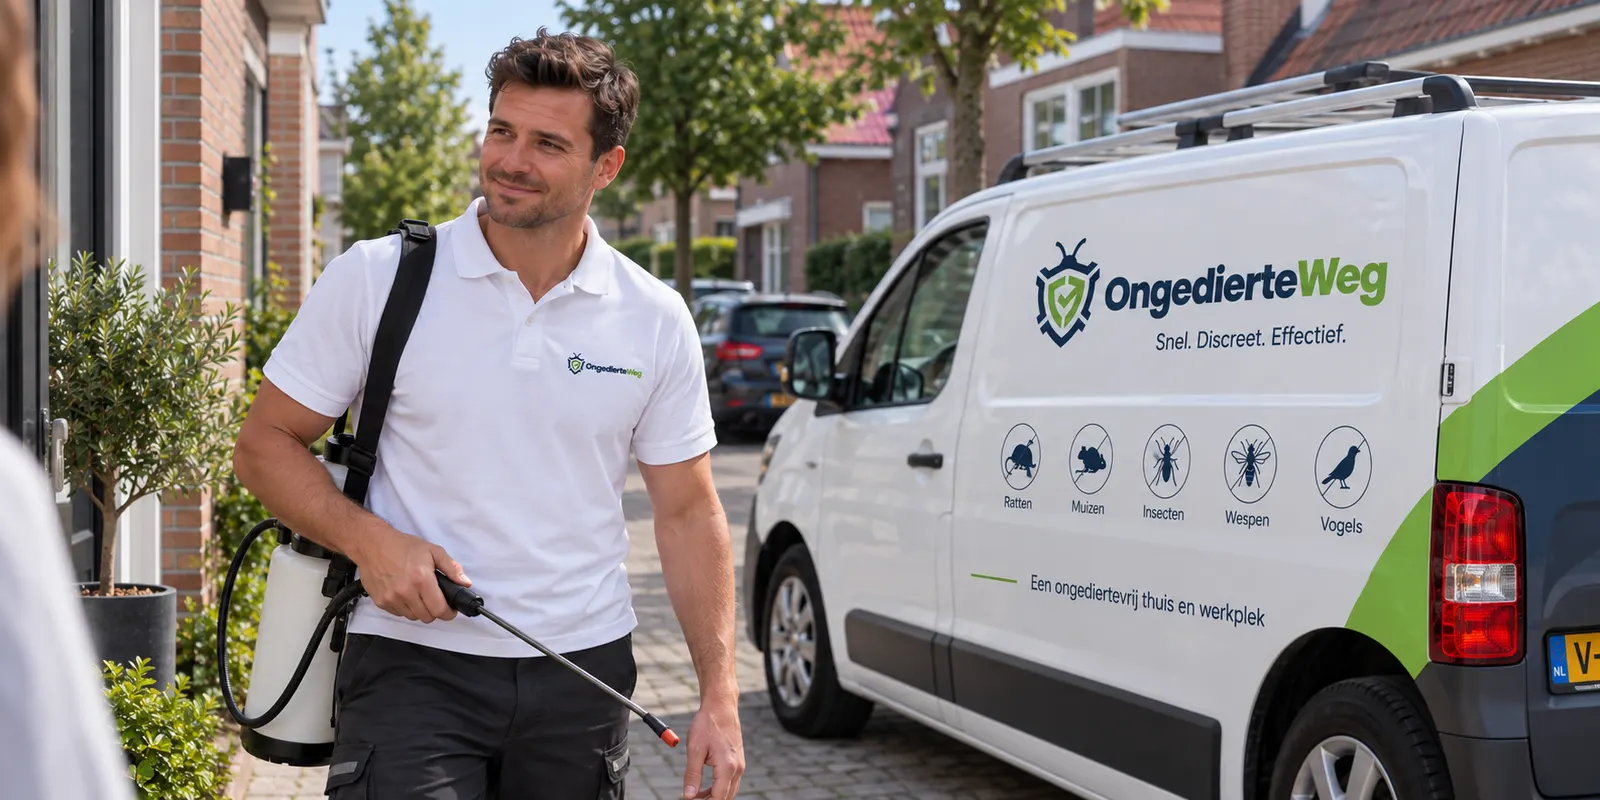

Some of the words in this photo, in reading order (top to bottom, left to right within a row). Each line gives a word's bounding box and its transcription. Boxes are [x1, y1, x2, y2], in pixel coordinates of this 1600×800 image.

[1105, 257, 1388, 319] OngedierteWeg
[1155, 332, 1191, 351] Snel.
[1197, 329, 1265, 349] Discreet.
[1271, 323, 1346, 346] Effectief.
[585, 363, 642, 379] OngedierteWeg
[1003, 496, 1033, 510] Ratten
[1071, 500, 1105, 515] Muizen
[1143, 505, 1185, 521] Insecten
[1225, 510, 1270, 529] Wespen
[1320, 516, 1363, 536] Vogels
[1031, 574, 1052, 593] Een
[1055, 580, 1139, 612] ongediertevrij
[1142, 591, 1175, 613] thuis
[1178, 601, 1195, 617] en
[1199, 602, 1266, 628] werkplek
[1553, 666, 1566, 677] NL
